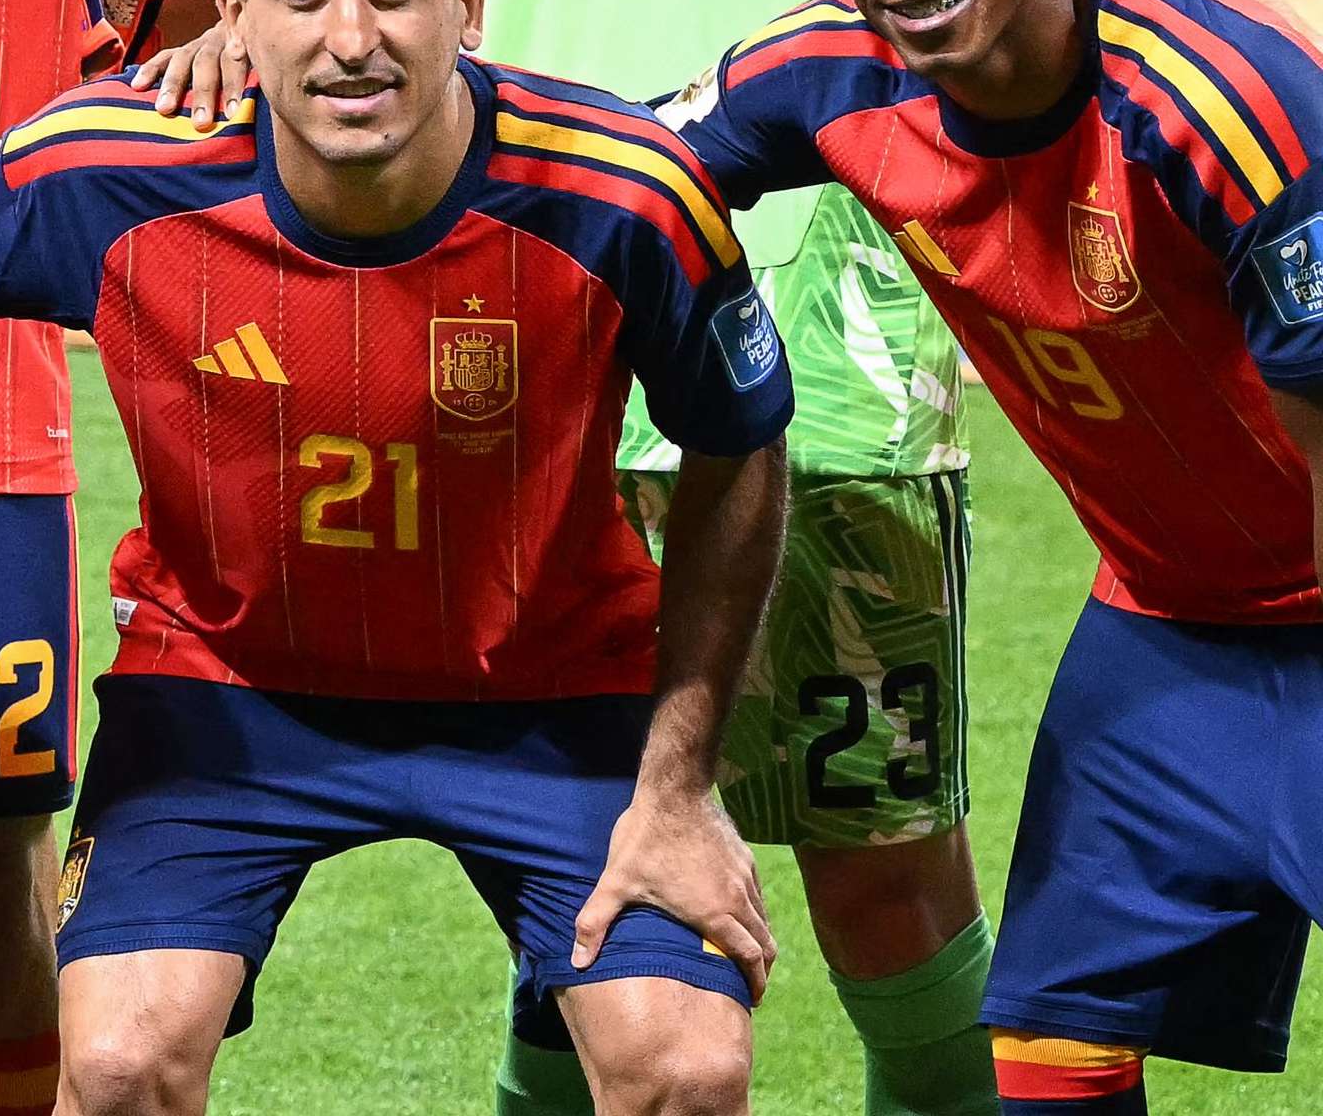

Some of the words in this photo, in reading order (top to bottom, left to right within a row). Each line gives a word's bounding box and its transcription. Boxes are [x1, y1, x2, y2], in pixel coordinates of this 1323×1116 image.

[987, 314, 1127, 422] 19
[297, 433, 420, 551] 21
[797, 661, 941, 810] 23
